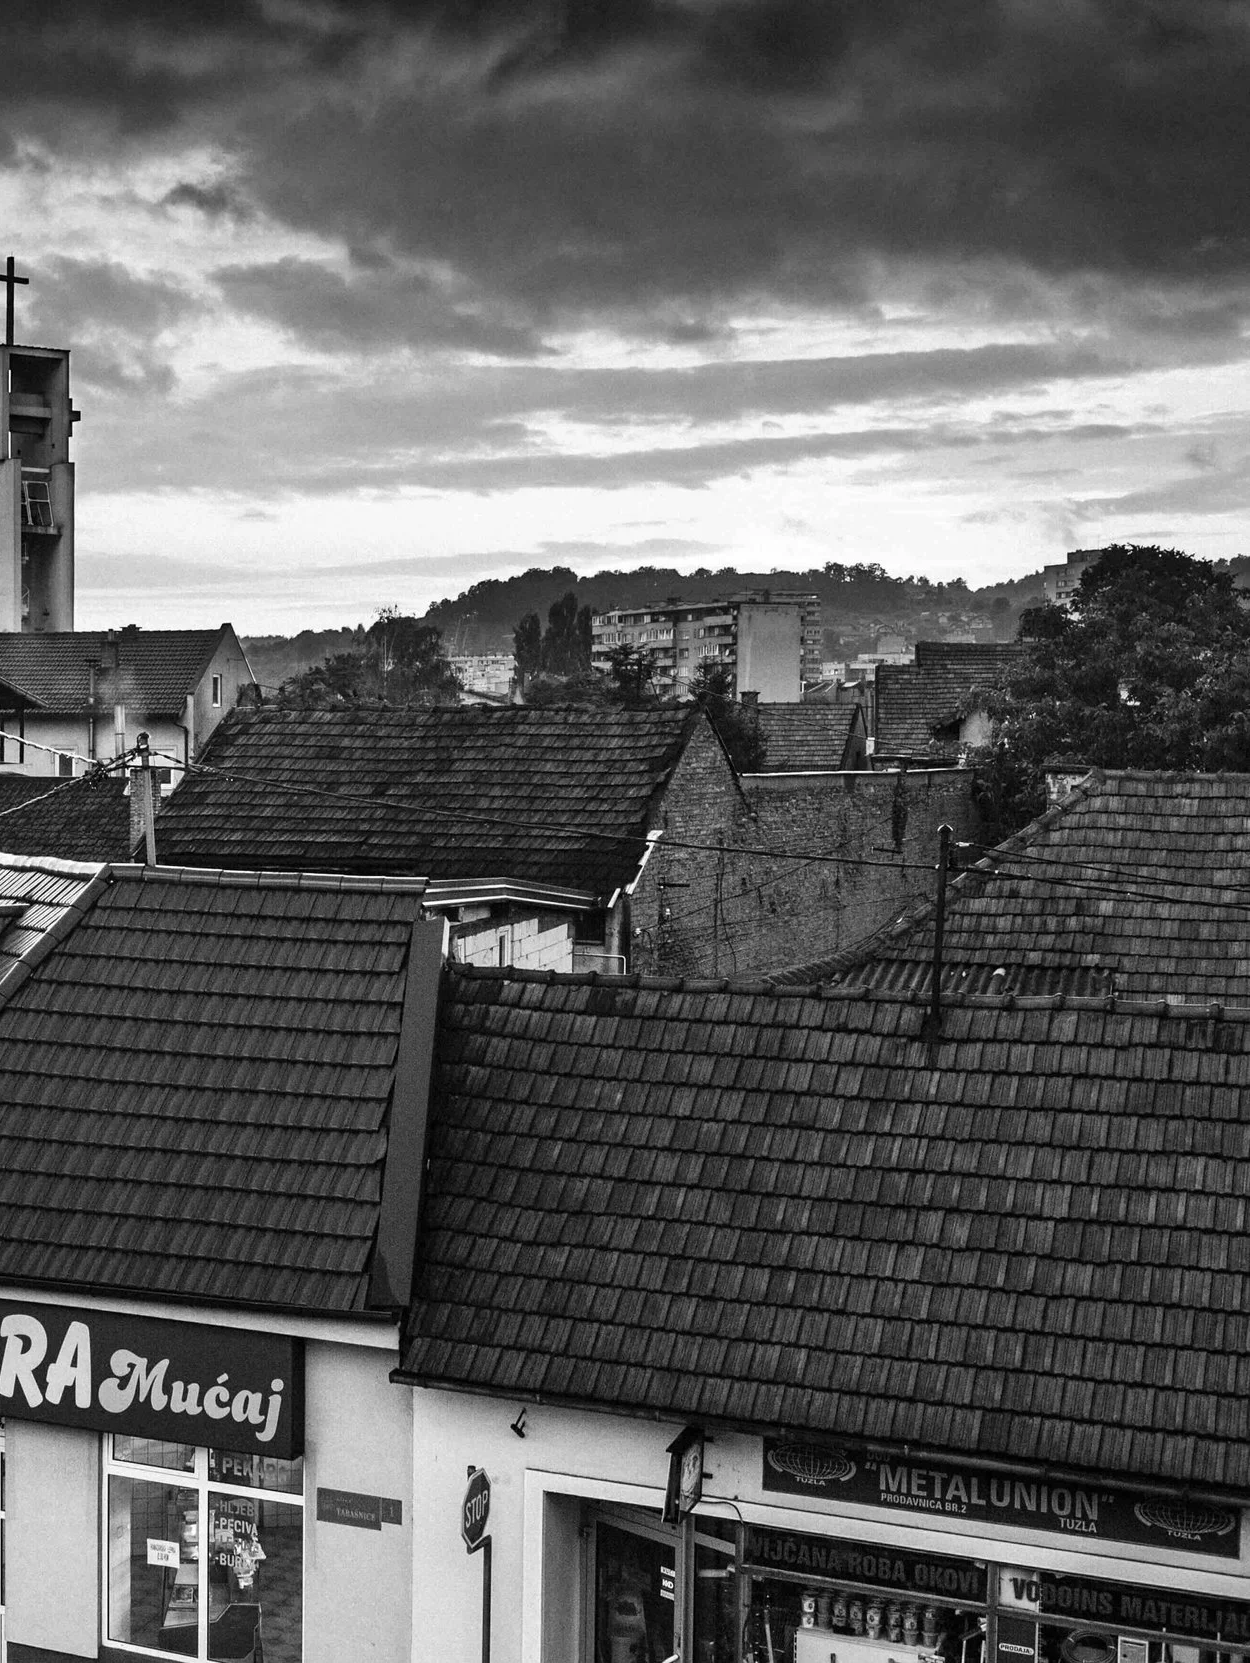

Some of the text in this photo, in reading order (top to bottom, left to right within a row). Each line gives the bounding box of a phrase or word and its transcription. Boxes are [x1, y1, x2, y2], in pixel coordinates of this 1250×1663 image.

[98, 1348, 286, 1442] Mućaj
[795, 1475, 826, 1486] TUZLA
[465, 1490, 488, 1528] STOP
[881, 1492, 943, 1511] PRODAVNICA
[1059, 1517, 1098, 1534] TUZLA
[1167, 1530, 1202, 1541] TUZLA
[914, 1562, 980, 1595] OKOVI
